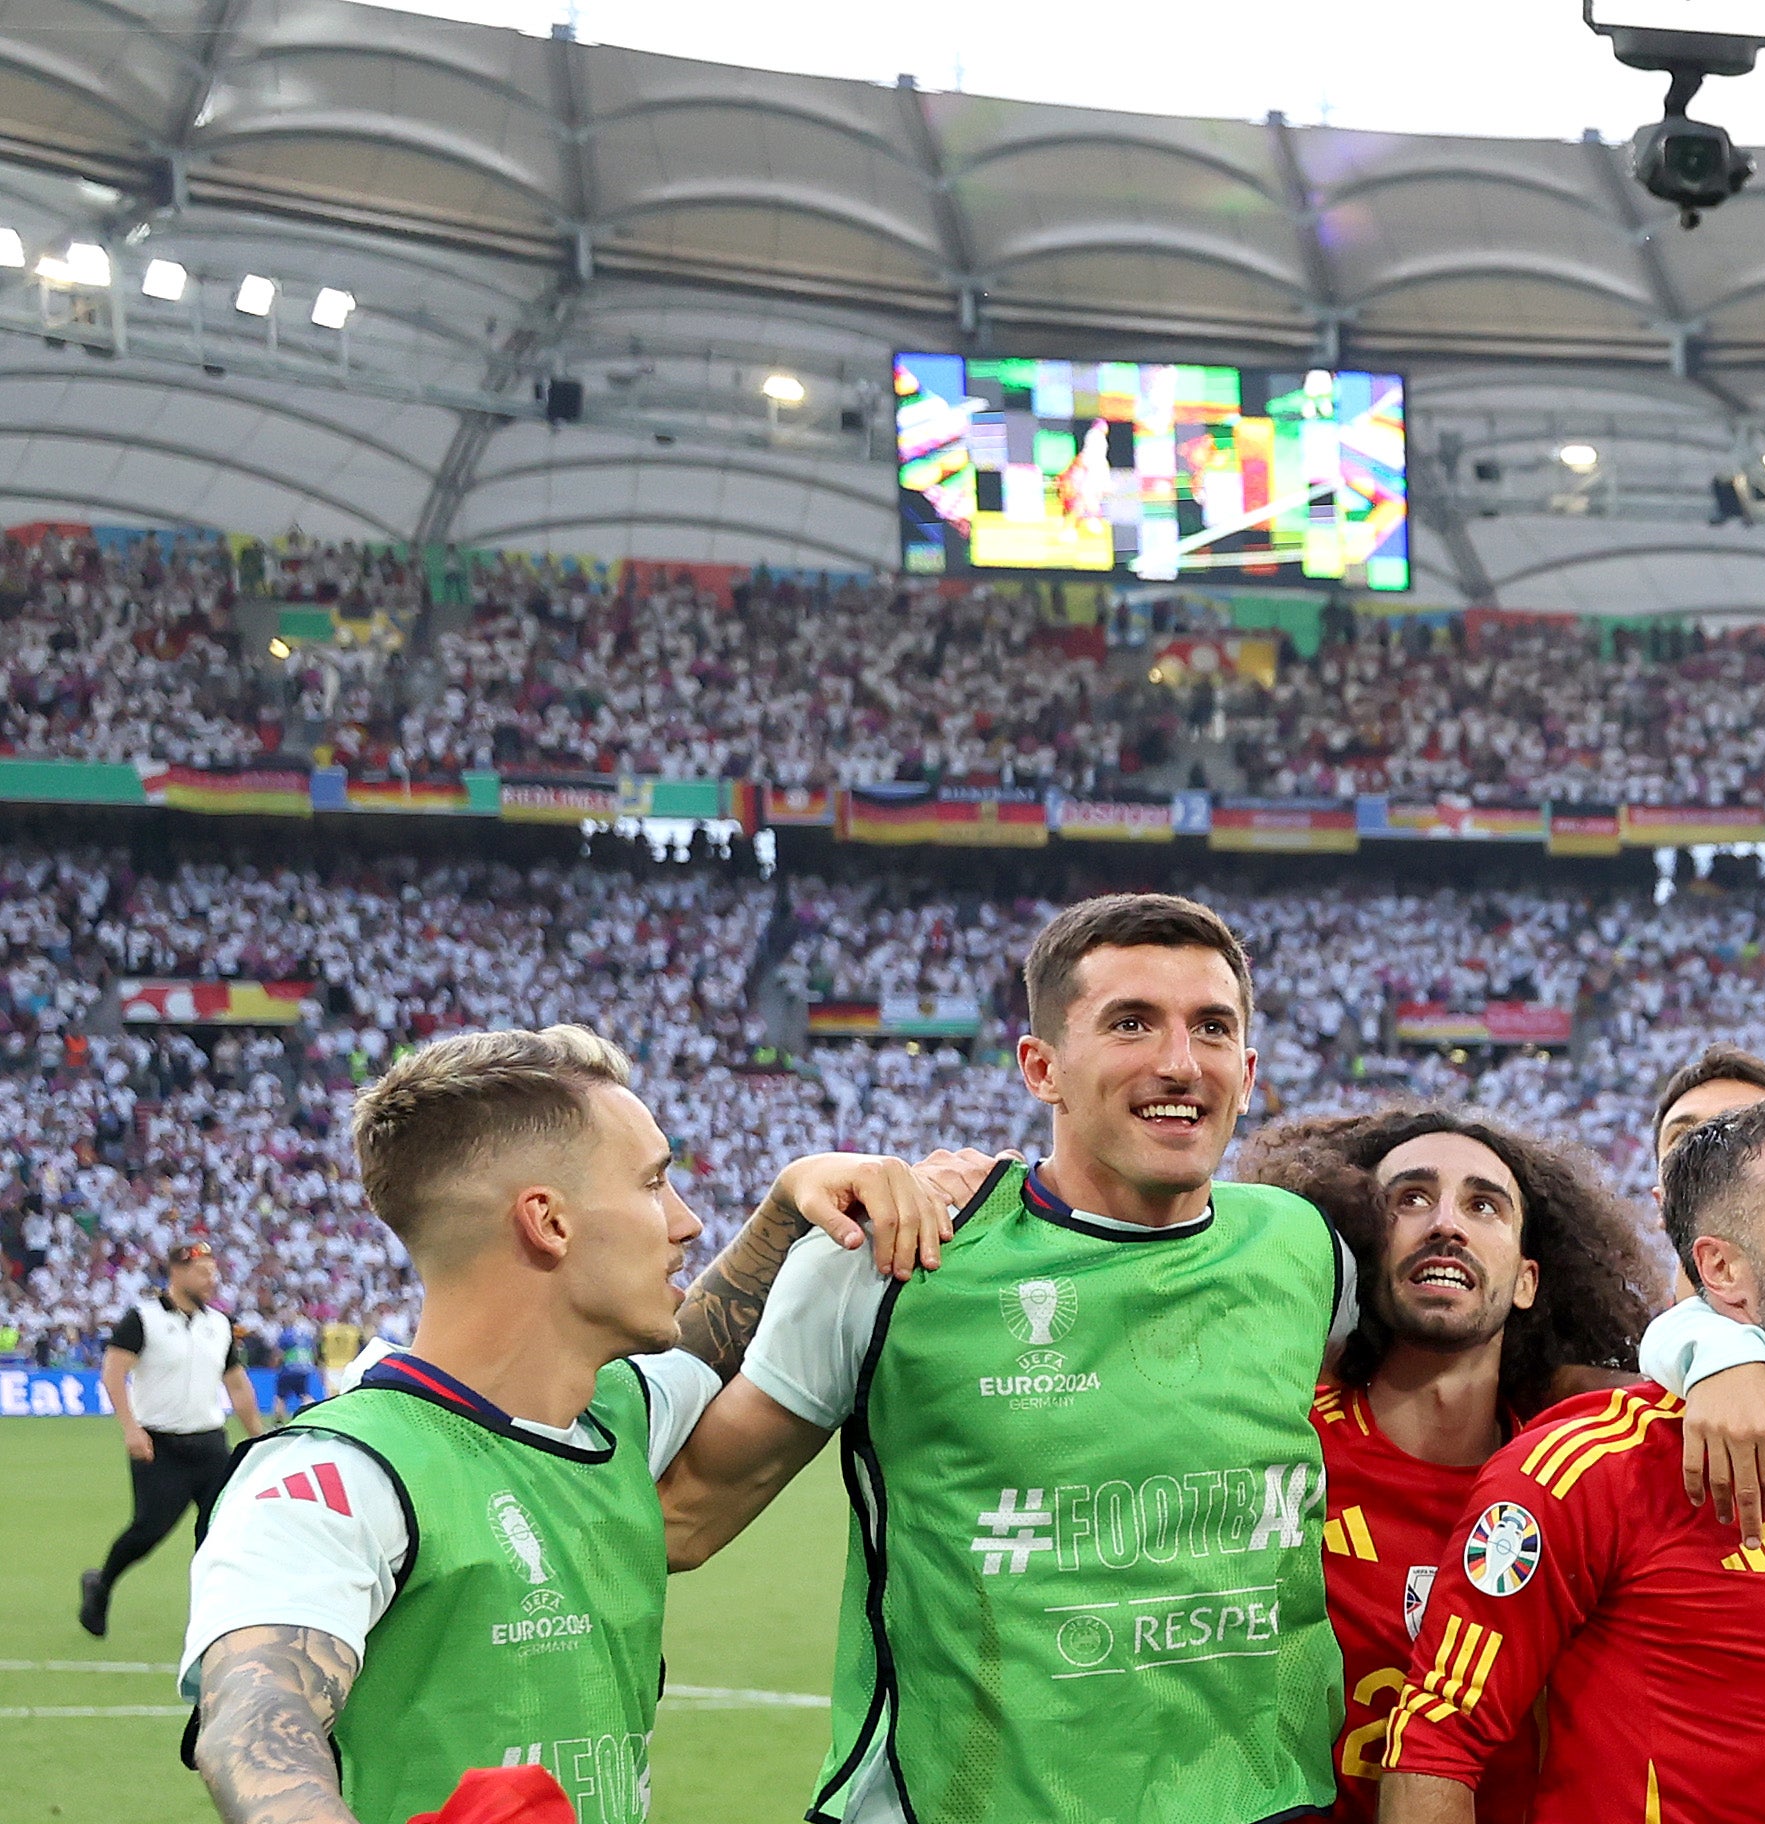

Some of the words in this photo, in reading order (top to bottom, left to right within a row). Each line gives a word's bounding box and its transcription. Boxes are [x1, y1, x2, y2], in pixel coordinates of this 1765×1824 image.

[1018, 1351, 1064, 1371] UEFA
[0, 1371, 86, 1416] Eat
[1009, 1397, 1074, 1411] GERMANY
[523, 1594, 562, 1612] UEFA
